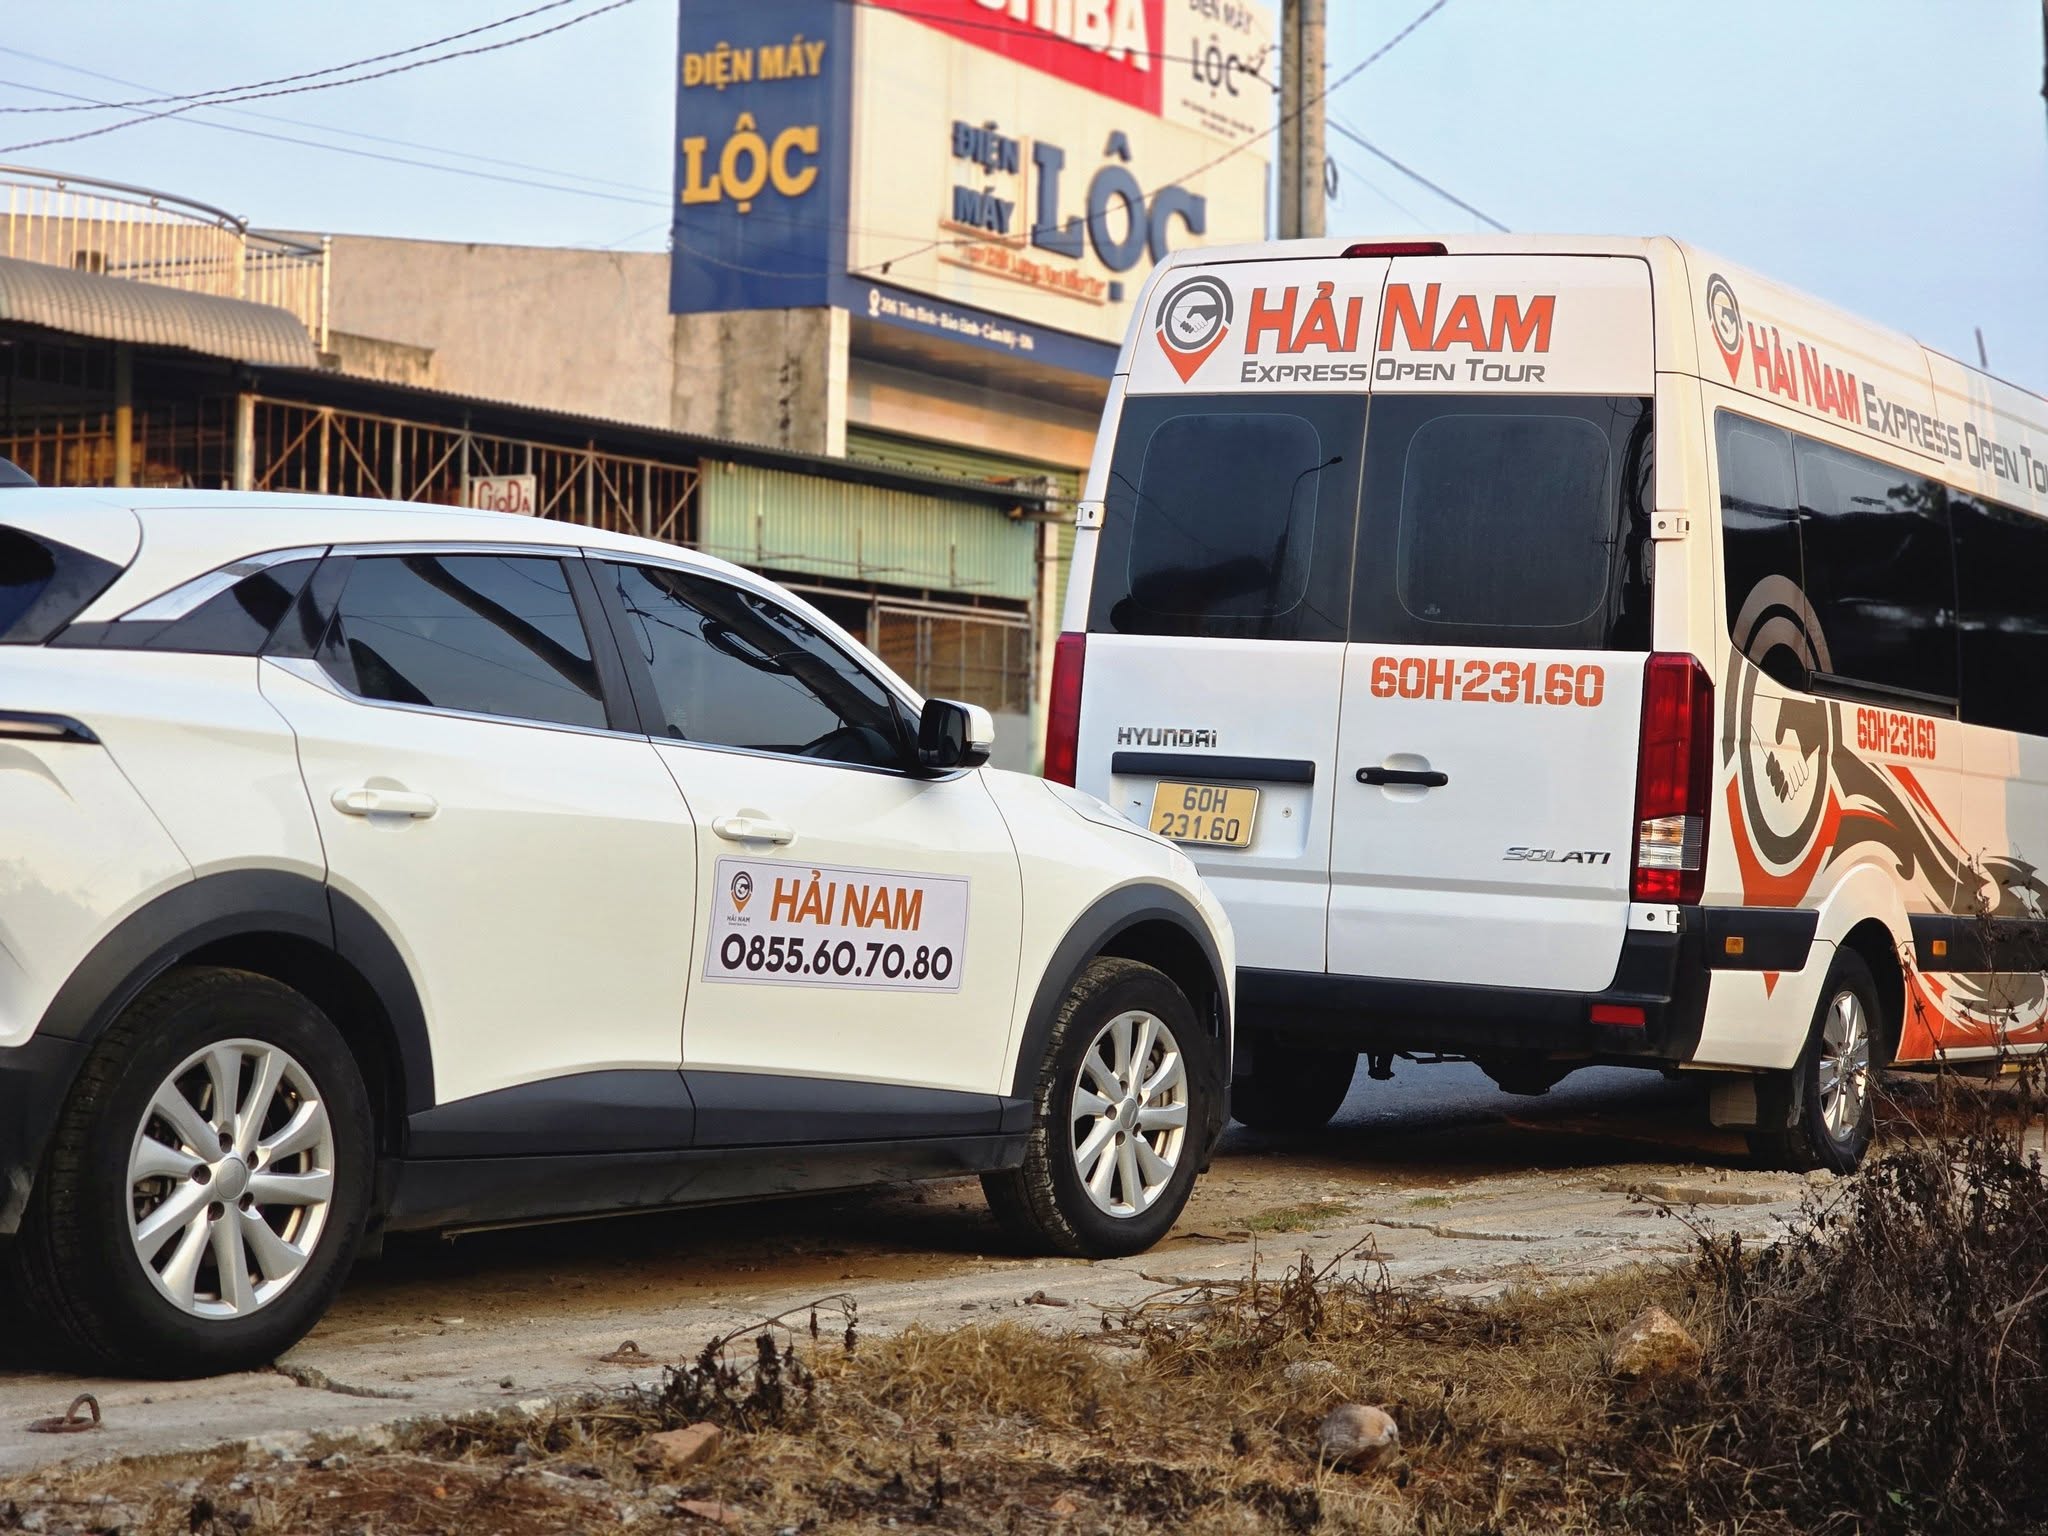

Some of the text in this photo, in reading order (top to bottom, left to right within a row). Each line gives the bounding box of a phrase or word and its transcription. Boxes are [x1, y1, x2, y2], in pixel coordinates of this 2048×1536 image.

[683, 34, 826, 91] ĐIỆN MÁY
[1192, 33, 1239, 98] LỘC
[681, 112, 819, 213] LỘC
[952, 120, 1019, 175] ĐIỆN
[953, 185, 1015, 234] MÁY
[1031, 129, 1206, 303] LỘC
[1244, 281, 1556, 355] HẢI NAM
[1240, 358, 1546, 384] EXPRESS OPEN TOUR
[1747, 321, 1862, 425] HẢI NAM
[1861, 382, 1962, 459] EXPRESS
[1964, 422, 2020, 484] OPEN
[1117, 727, 1217, 748] HYUNDAI
[1159, 812, 1240, 842] 231.60
[1183, 787, 1229, 814] 60H
[1502, 846, 1611, 865] SOLATI
[769, 869, 923, 931] HẢI NAM
[720, 933, 953, 981] 0855.60.70.80
